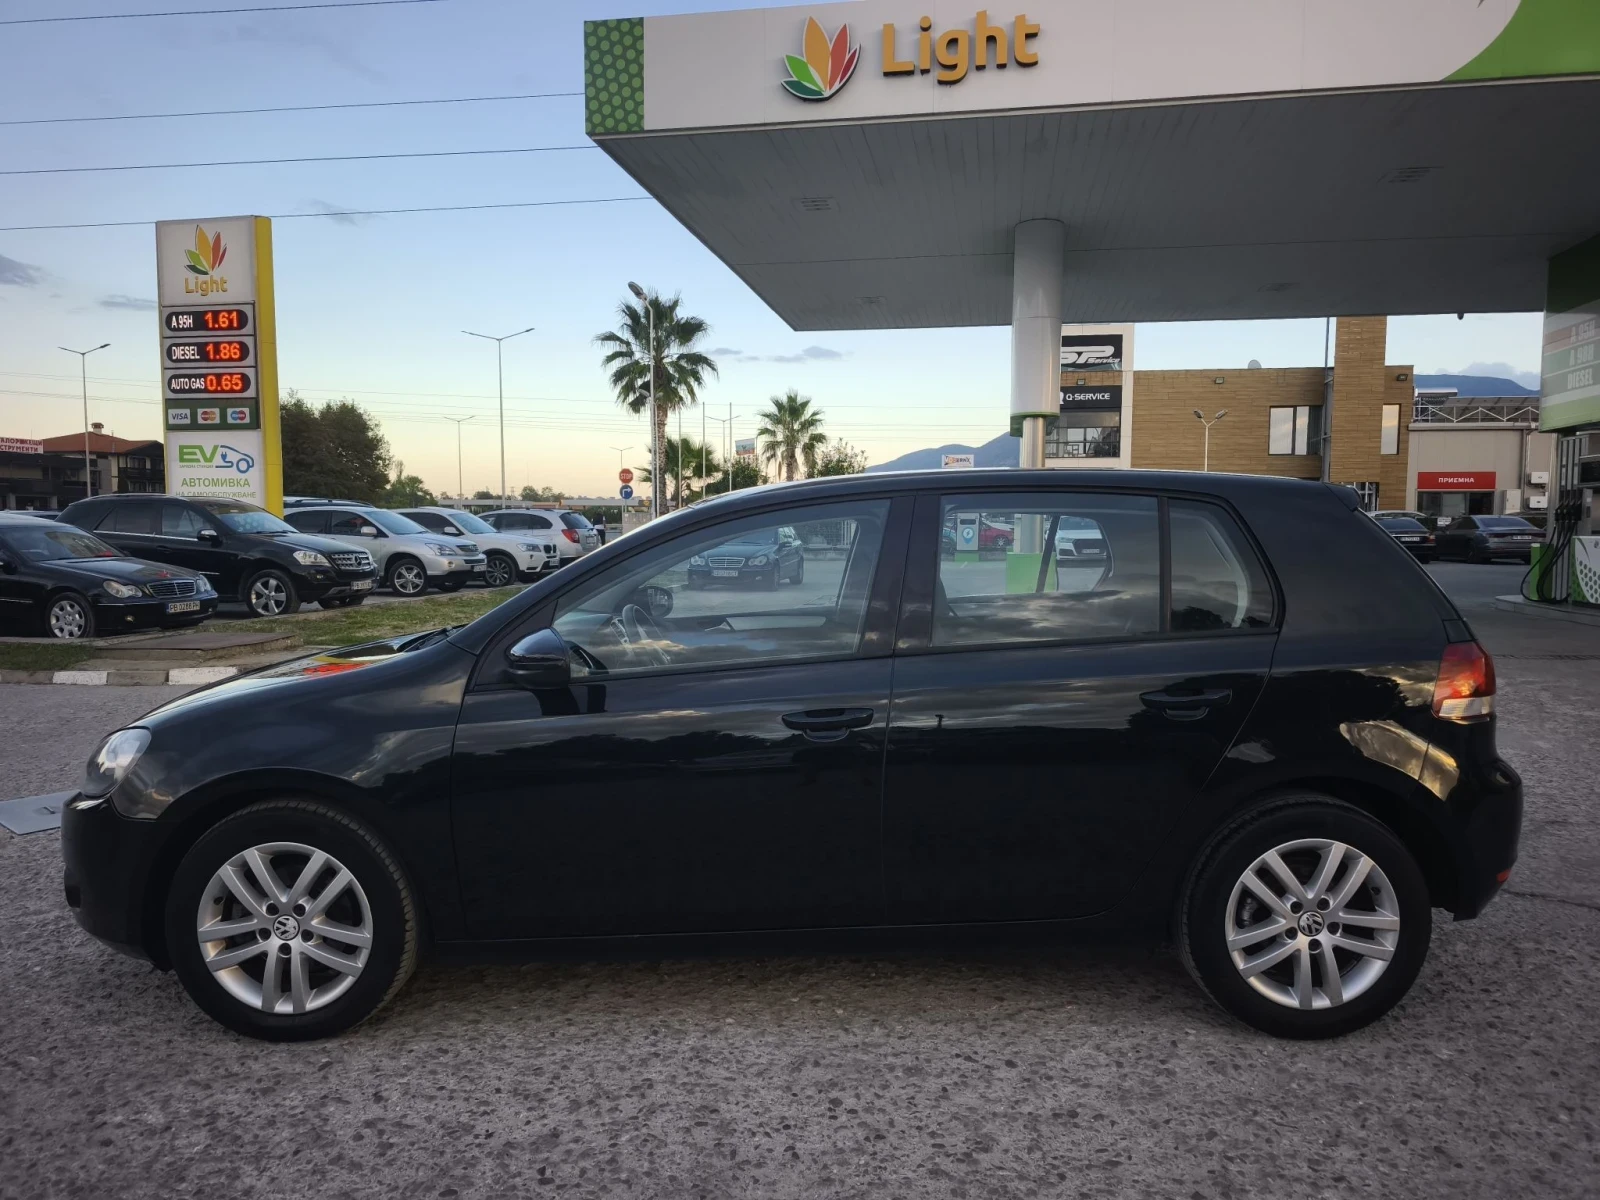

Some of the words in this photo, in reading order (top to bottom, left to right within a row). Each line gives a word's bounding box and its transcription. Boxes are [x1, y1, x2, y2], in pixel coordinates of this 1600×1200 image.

[883, 10, 1040, 84] Light
[184, 275, 228, 296] Light
[171, 315, 178, 328] A
[178, 315, 193, 328] 95H
[204, 311, 238, 328] 1.61
[171, 346, 200, 359] DIESEL
[206, 343, 240, 359] 1.86
[171, 378, 190, 389] AUTO
[190, 378, 205, 389] GAS
[206, 375, 243, 390] 0.65
[1567, 368, 1593, 389] DIESEL
[178, 444, 219, 463] EV
[181, 477, 251, 488] АВТОМИВКА
[620, 472, 633, 480] STOP
